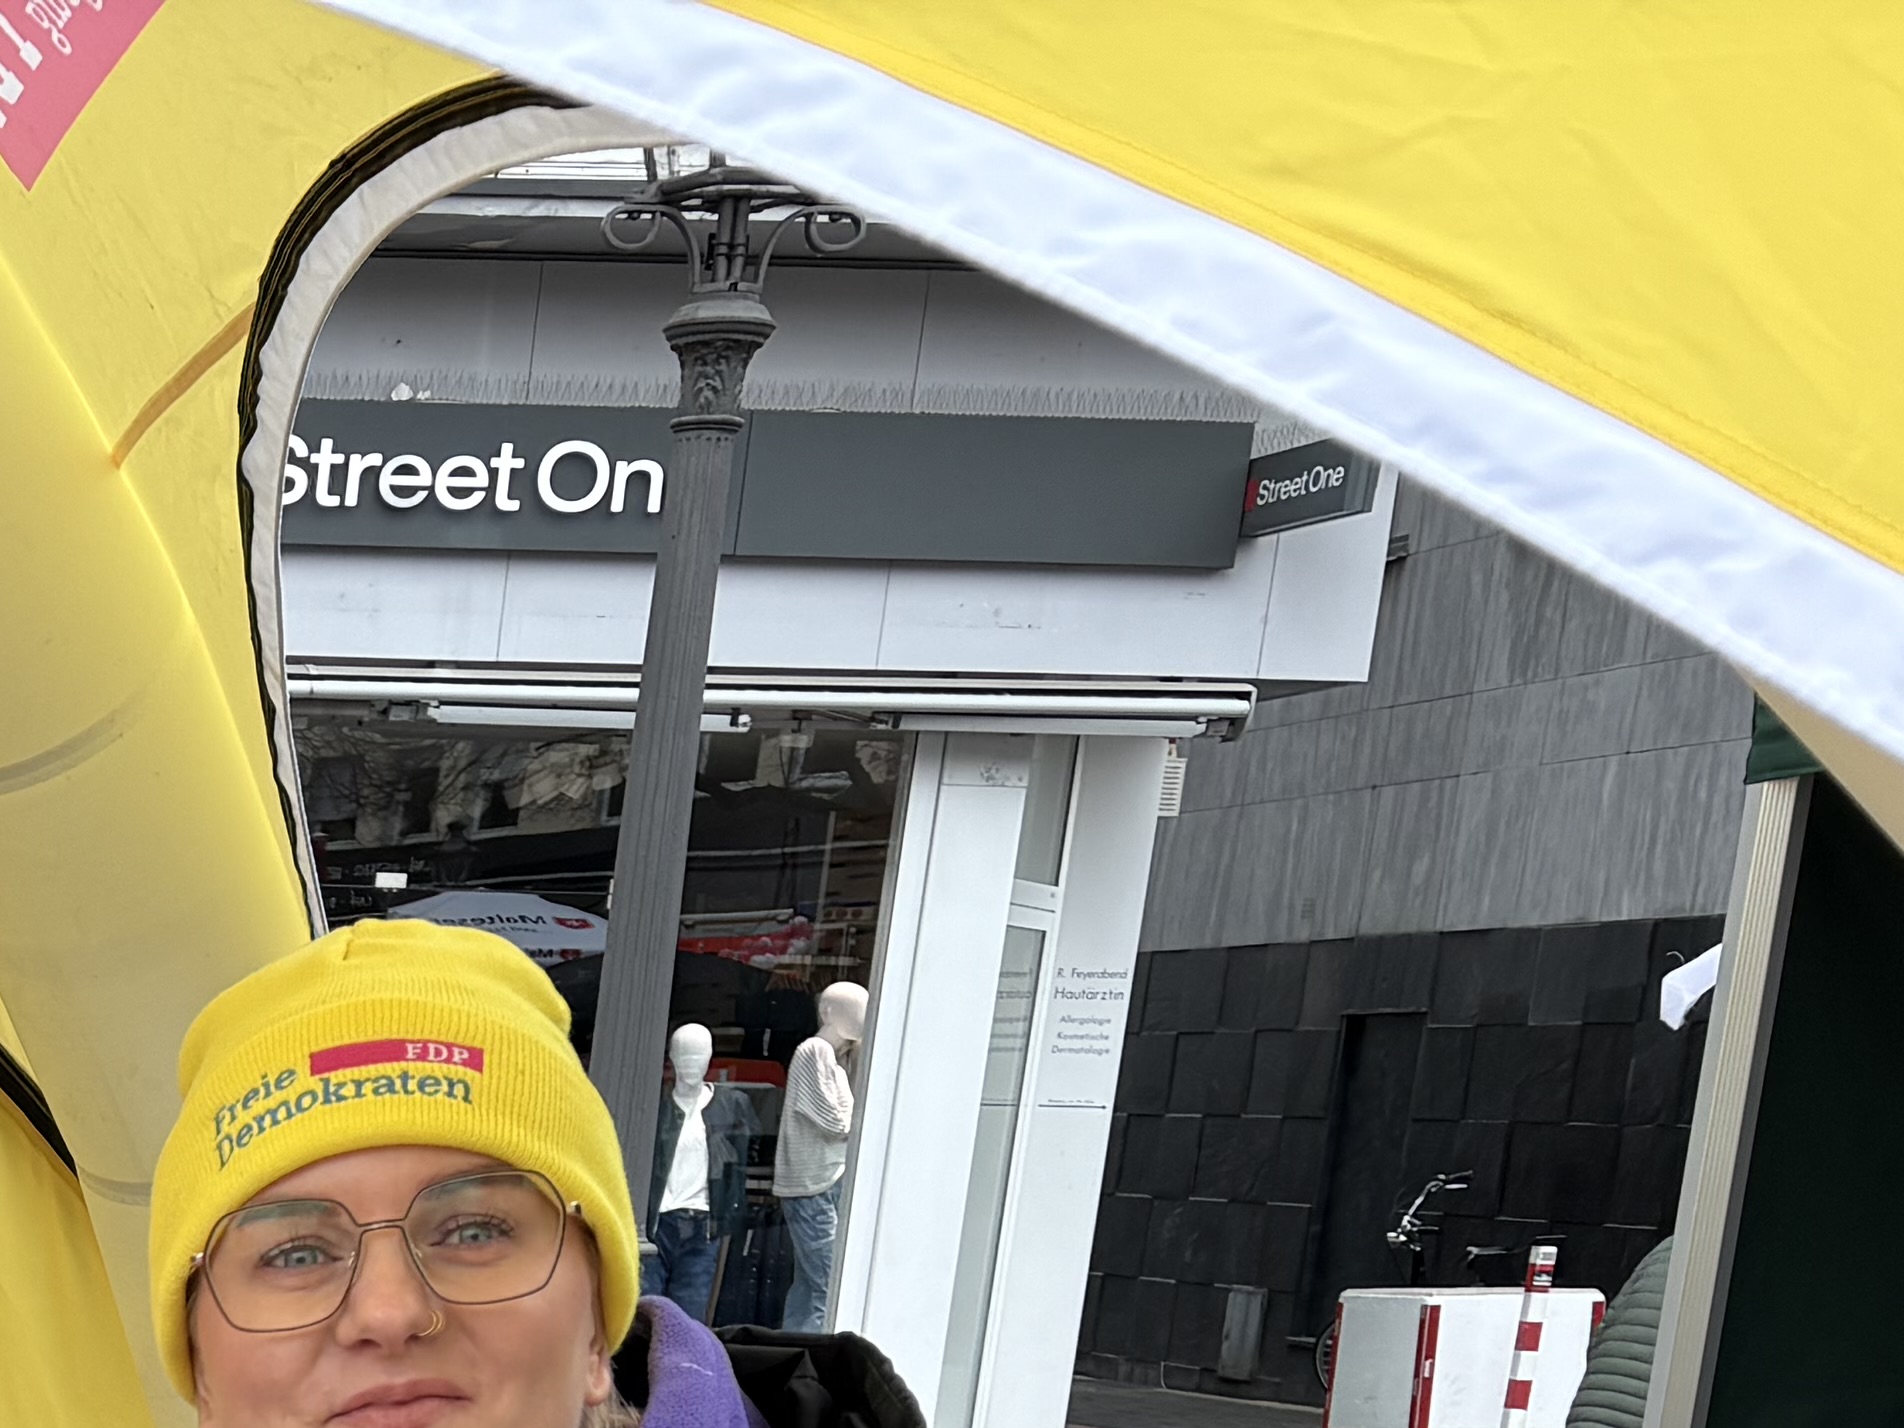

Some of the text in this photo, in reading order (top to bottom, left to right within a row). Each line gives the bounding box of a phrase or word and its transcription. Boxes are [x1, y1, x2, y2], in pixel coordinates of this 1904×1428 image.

[281, 432, 665, 514] Street On
[1256, 465, 1345, 506] Street One
[1053, 986, 1125, 1001] Hautärztin
[404, 1040, 471, 1064] FDP
[212, 1066, 298, 1141] Freie
[214, 1070, 474, 1172] Demokraten
